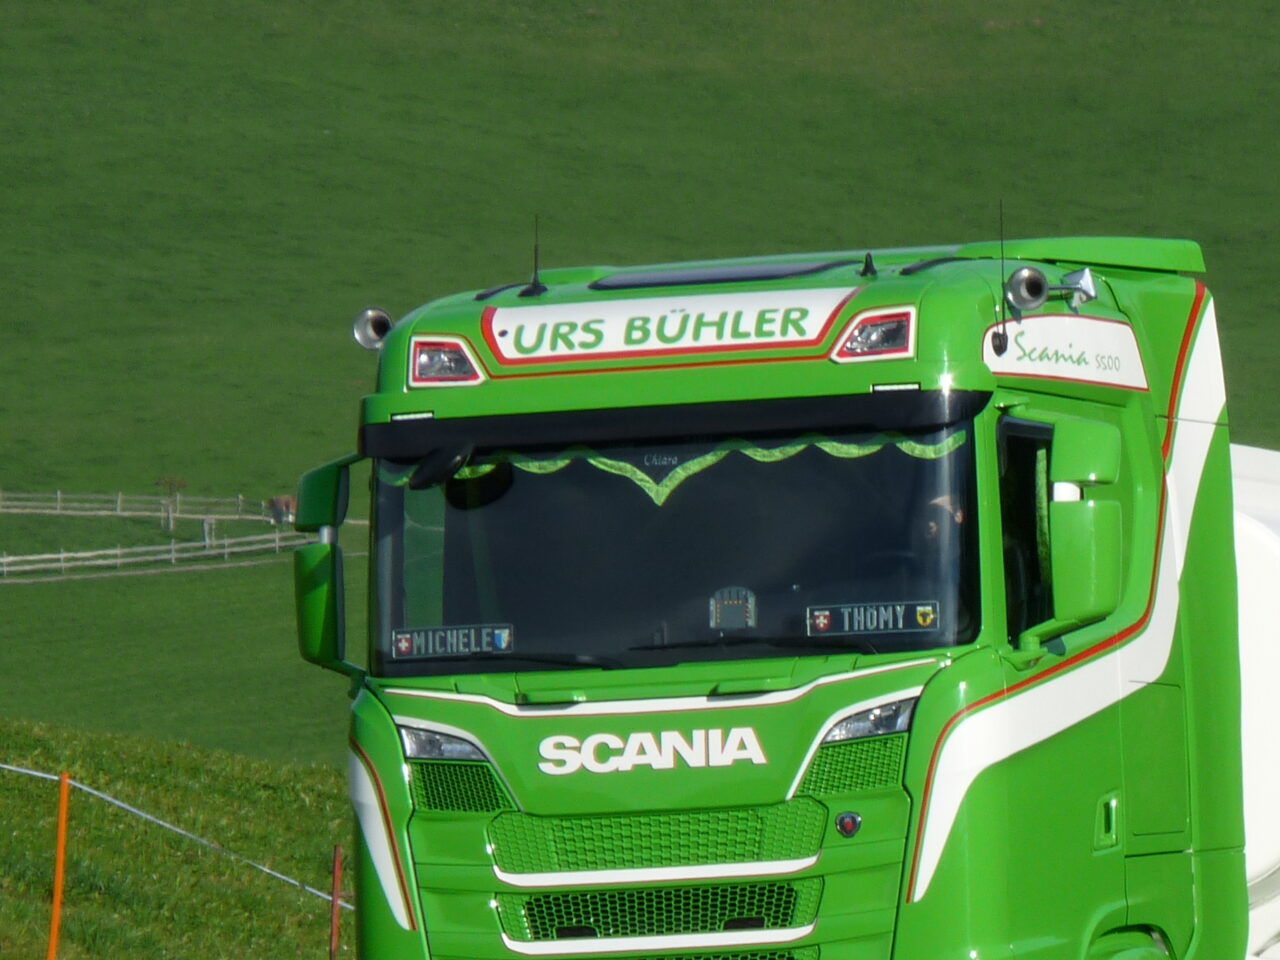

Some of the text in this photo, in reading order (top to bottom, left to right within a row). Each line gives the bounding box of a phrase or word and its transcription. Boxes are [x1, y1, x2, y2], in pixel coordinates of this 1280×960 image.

[513, 307, 809, 355] URS BÜHLER
[1014, 330, 1089, 366] Scania
[841, 605, 905, 632] THÖMY
[412, 628, 493, 655] MICHELE
[537, 727, 768, 776] SCANIA
